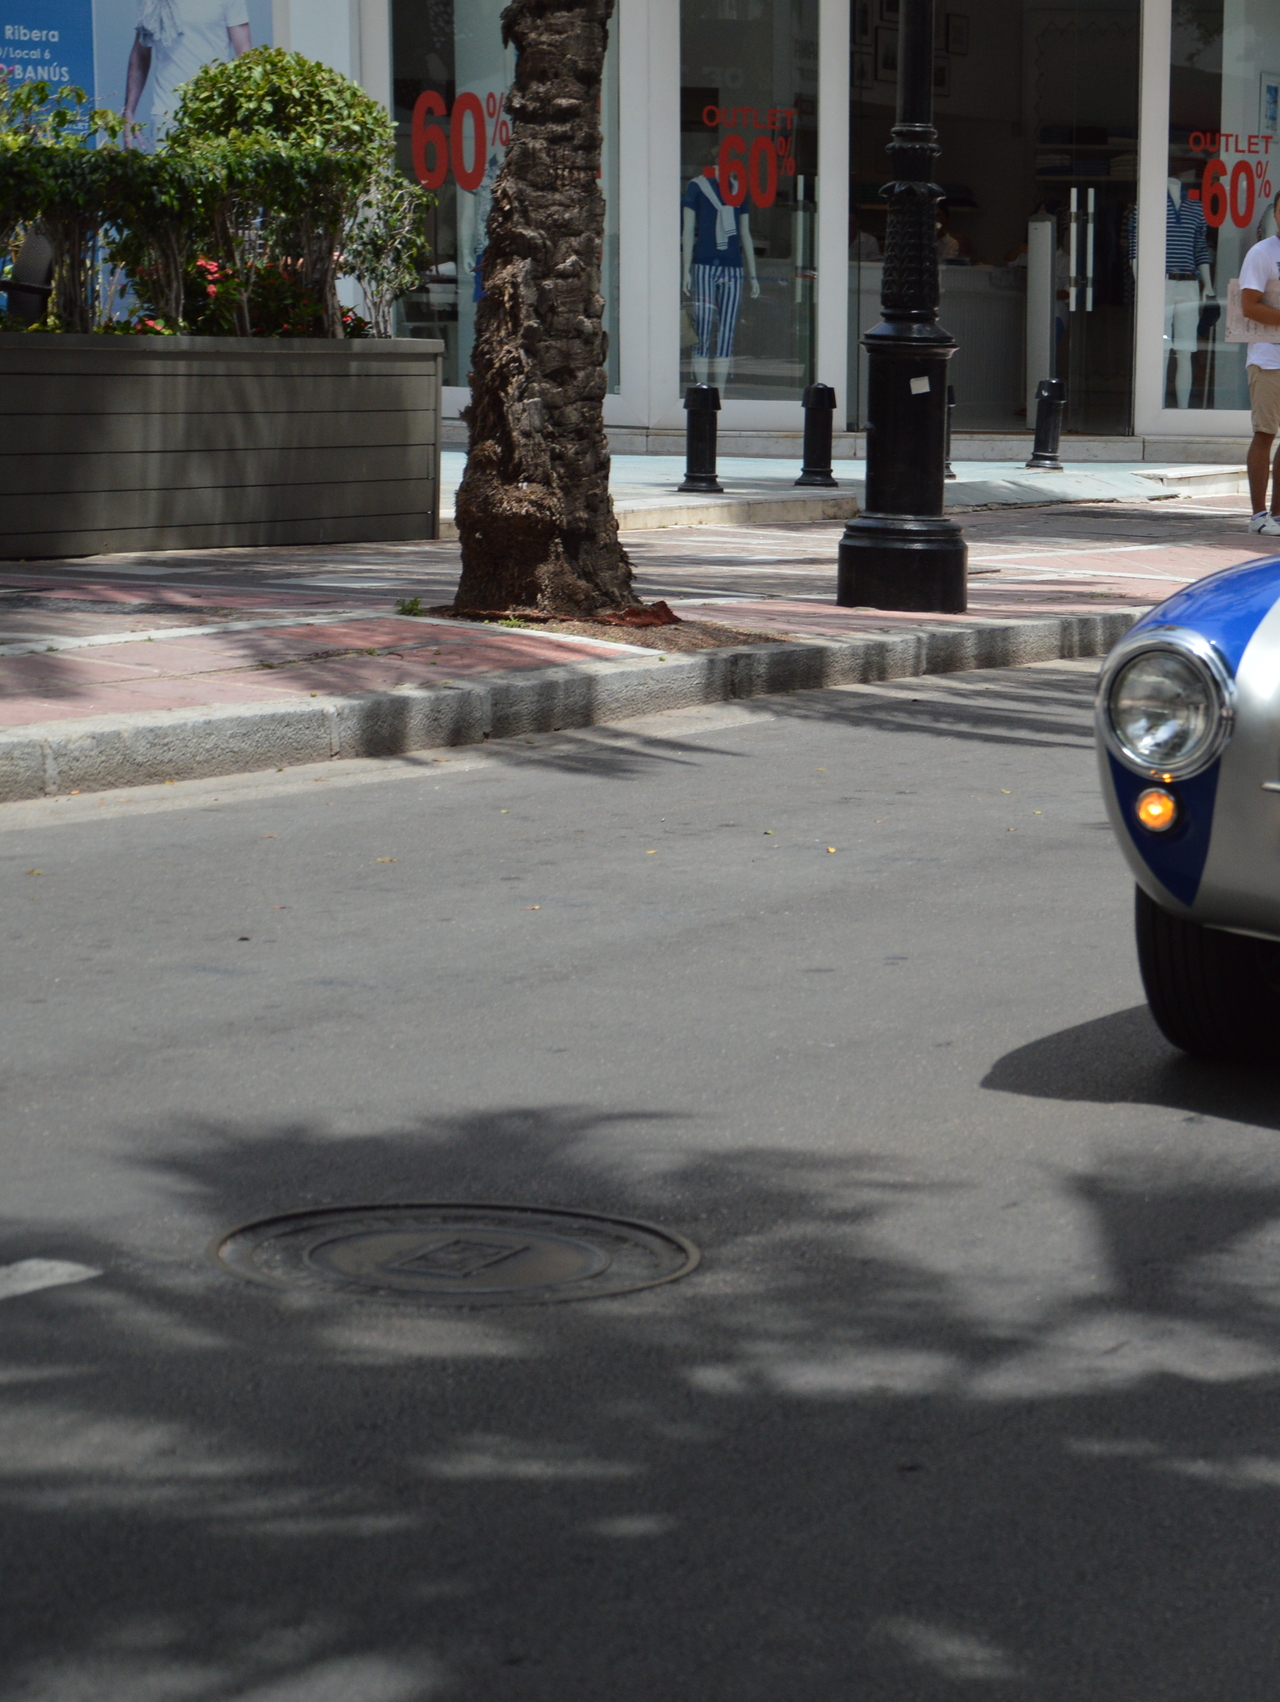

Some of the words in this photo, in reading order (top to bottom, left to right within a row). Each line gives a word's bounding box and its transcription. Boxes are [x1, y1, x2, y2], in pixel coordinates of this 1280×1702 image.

[4, 25, 59, 42] Ribera
[44, 49, 51, 59] 6
[14, 62, 70, 81] BANÚS
[702, 105, 797, 130] OUTLET
[411, 90, 510, 191] 60%
[1189, 131, 1274, 154] OUTLET
[702, 134, 797, 208] -60%
[1187, 158, 1272, 229] -60%
